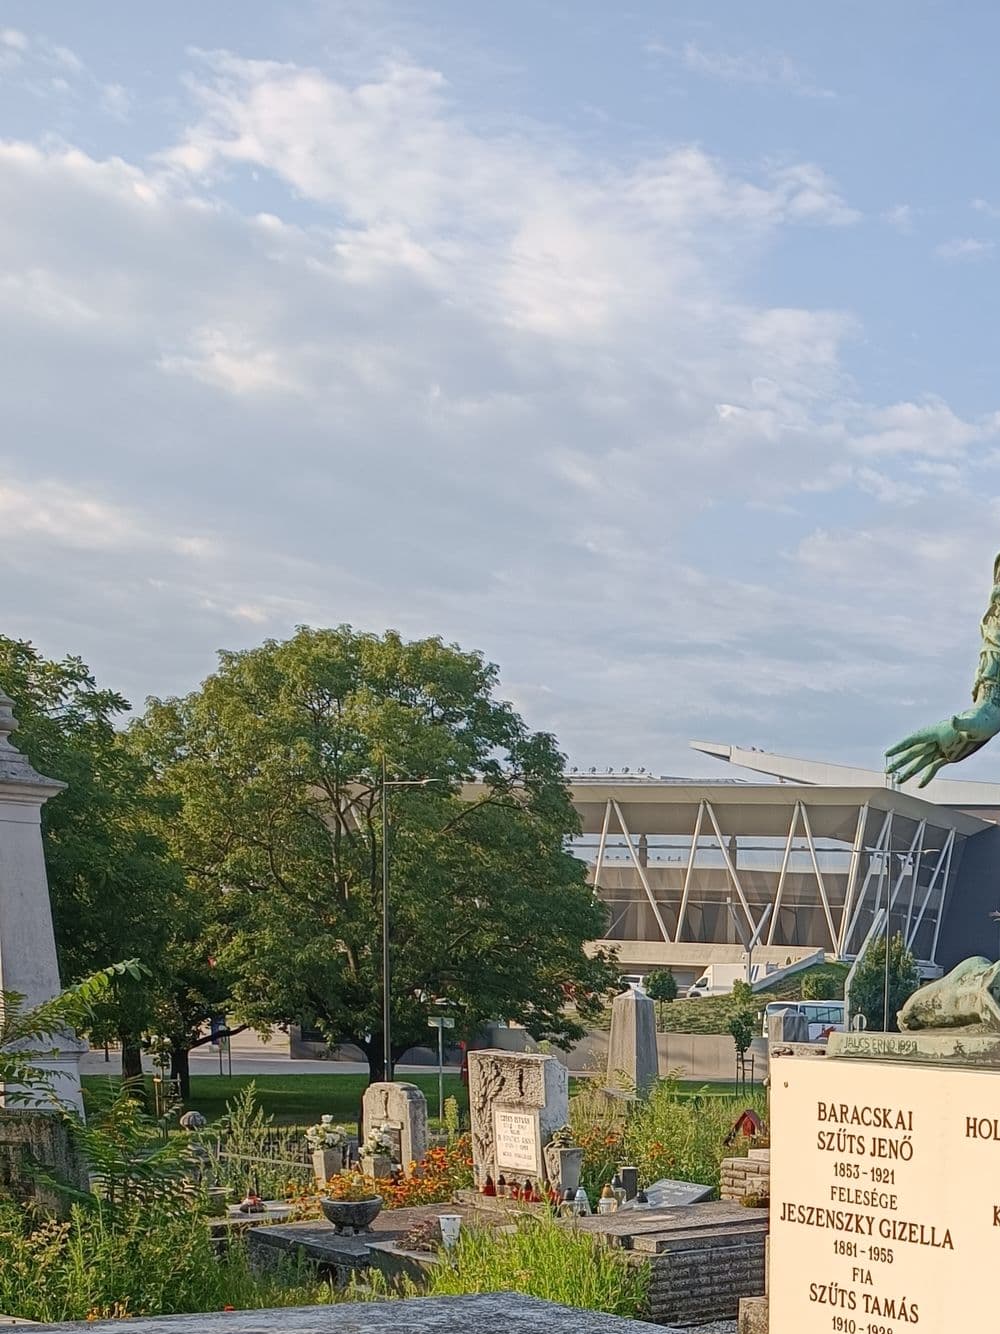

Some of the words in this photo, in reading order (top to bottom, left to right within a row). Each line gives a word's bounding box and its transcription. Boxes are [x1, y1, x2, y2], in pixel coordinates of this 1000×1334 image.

[817, 1101, 914, 1132] BARACSKAI
[816, 1127, 866, 1156] SZŰTS
[869, 1134, 914, 1162] JENŐ
[830, 1185, 899, 1211] FELESÉGE
[779, 1201, 876, 1237] JESZENSZKY
[878, 1218, 955, 1251] GIZELLA
[852, 1266, 874, 1286] FIA
[808, 1281, 857, 1311] SZŰTS
[861, 1293, 920, 1325] TAMÁS
